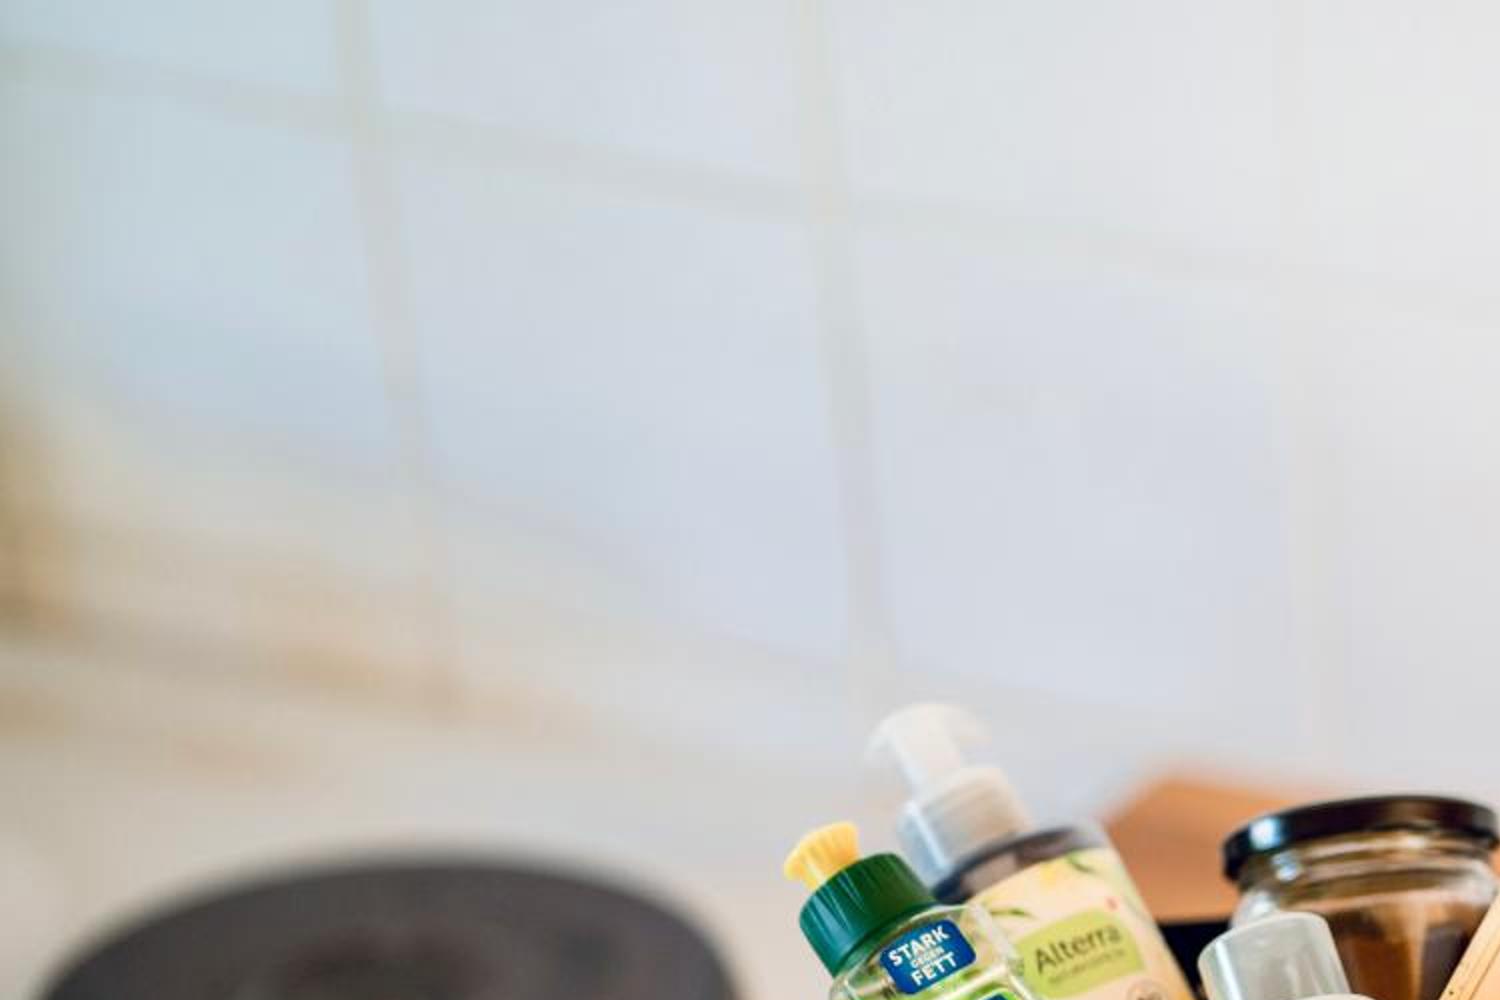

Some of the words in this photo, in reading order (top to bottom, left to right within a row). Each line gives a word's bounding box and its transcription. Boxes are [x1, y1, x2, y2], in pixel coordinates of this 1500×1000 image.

[888, 924, 950, 967] STARK
[1034, 924, 1123, 975] Alterra
[911, 951, 957, 986] FETT
